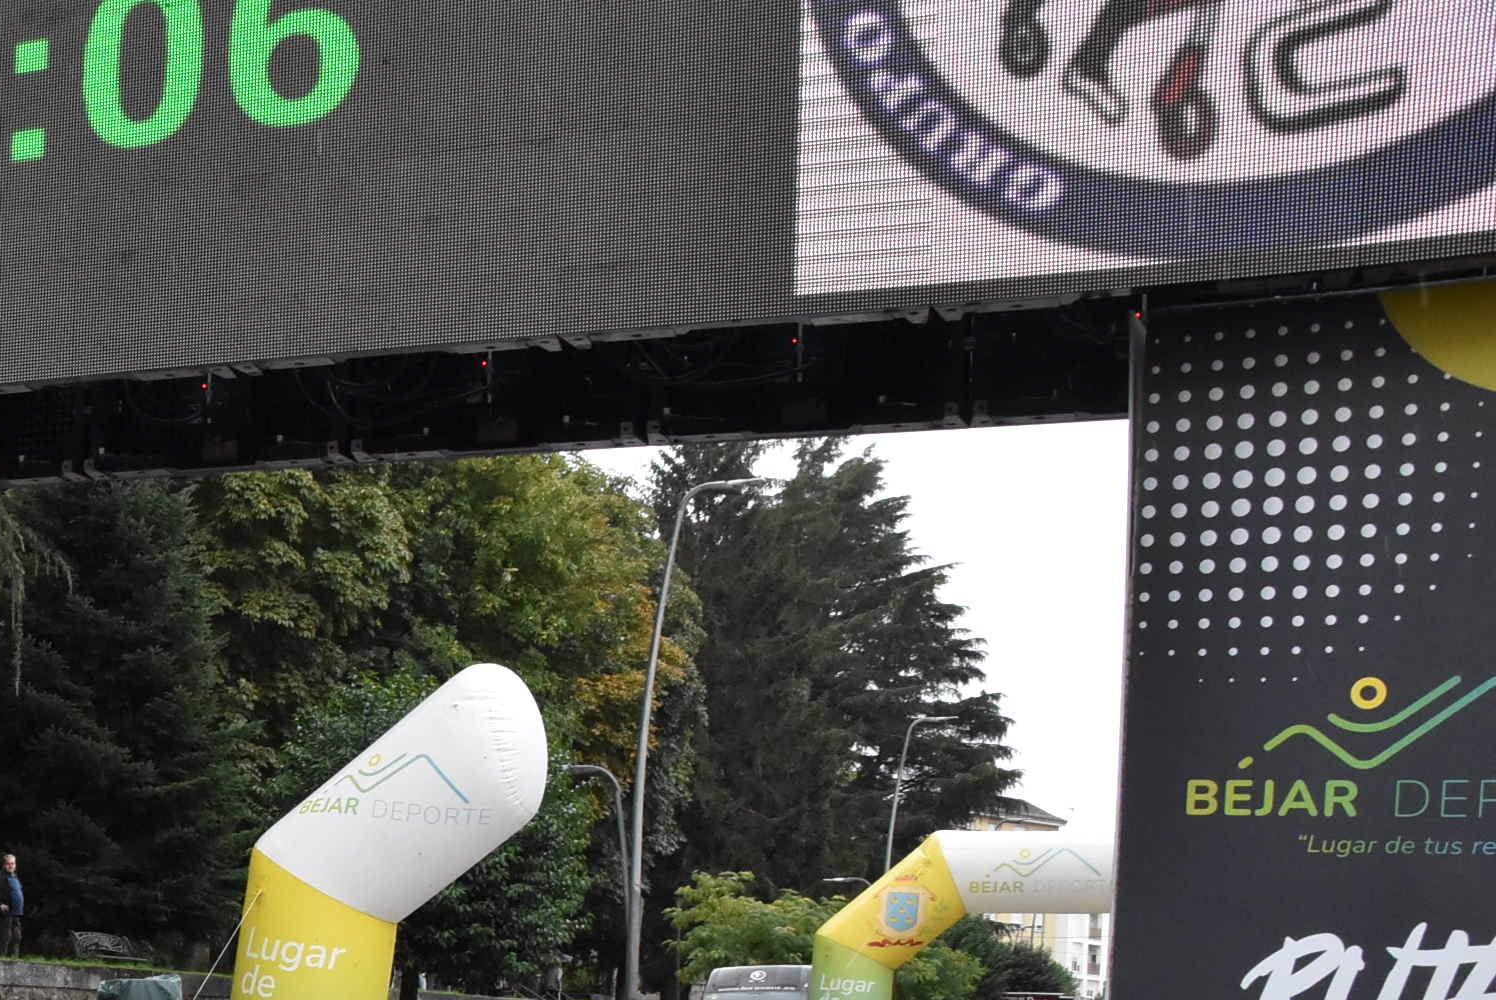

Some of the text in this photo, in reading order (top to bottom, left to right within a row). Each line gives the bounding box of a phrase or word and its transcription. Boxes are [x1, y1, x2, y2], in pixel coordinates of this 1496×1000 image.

[1185, 756, 1359, 817] BÉJAR
[371, 800, 494, 826] DEPORTE
[1384, 836, 1416, 855] de
[1424, 837, 1464, 856] tus
[246, 926, 347, 973] Lugar
[241, 963, 277, 999] de
[819, 973, 877, 996] Lugar
